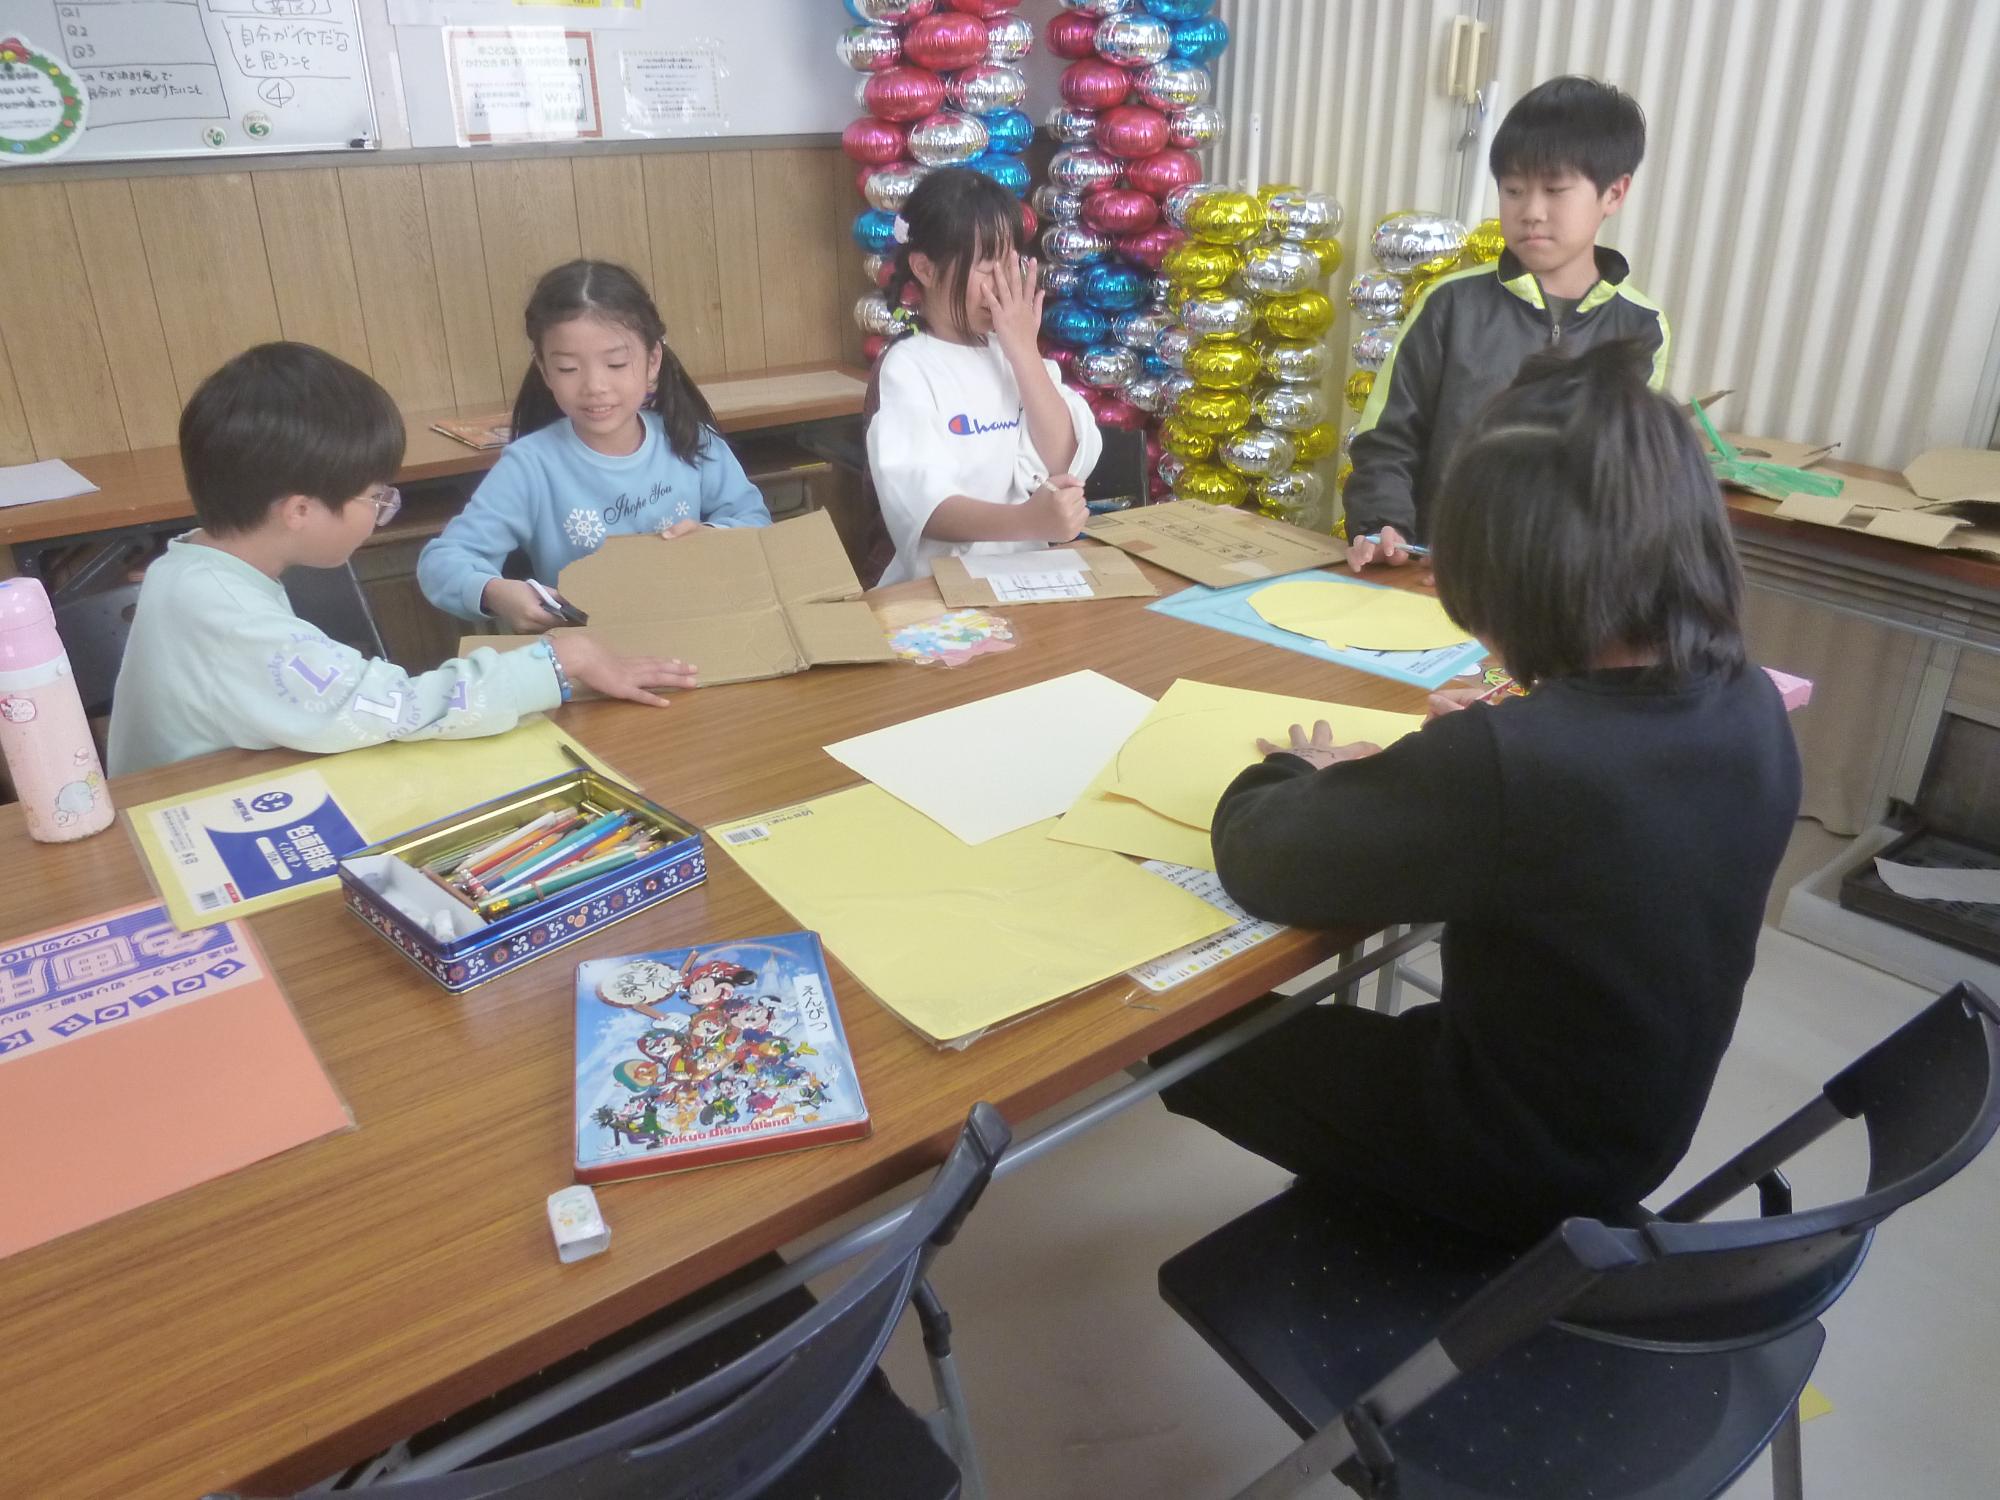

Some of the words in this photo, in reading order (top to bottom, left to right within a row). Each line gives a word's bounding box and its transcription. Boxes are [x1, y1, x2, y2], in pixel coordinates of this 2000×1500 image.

[61, 7, 80, 18] Q1
[66, 24, 88, 37] Q2
[72, 43, 96, 59] Q3
[286, 825, 338, 872] 色画用紙
[53, 961, 240, 1033] COLOR
